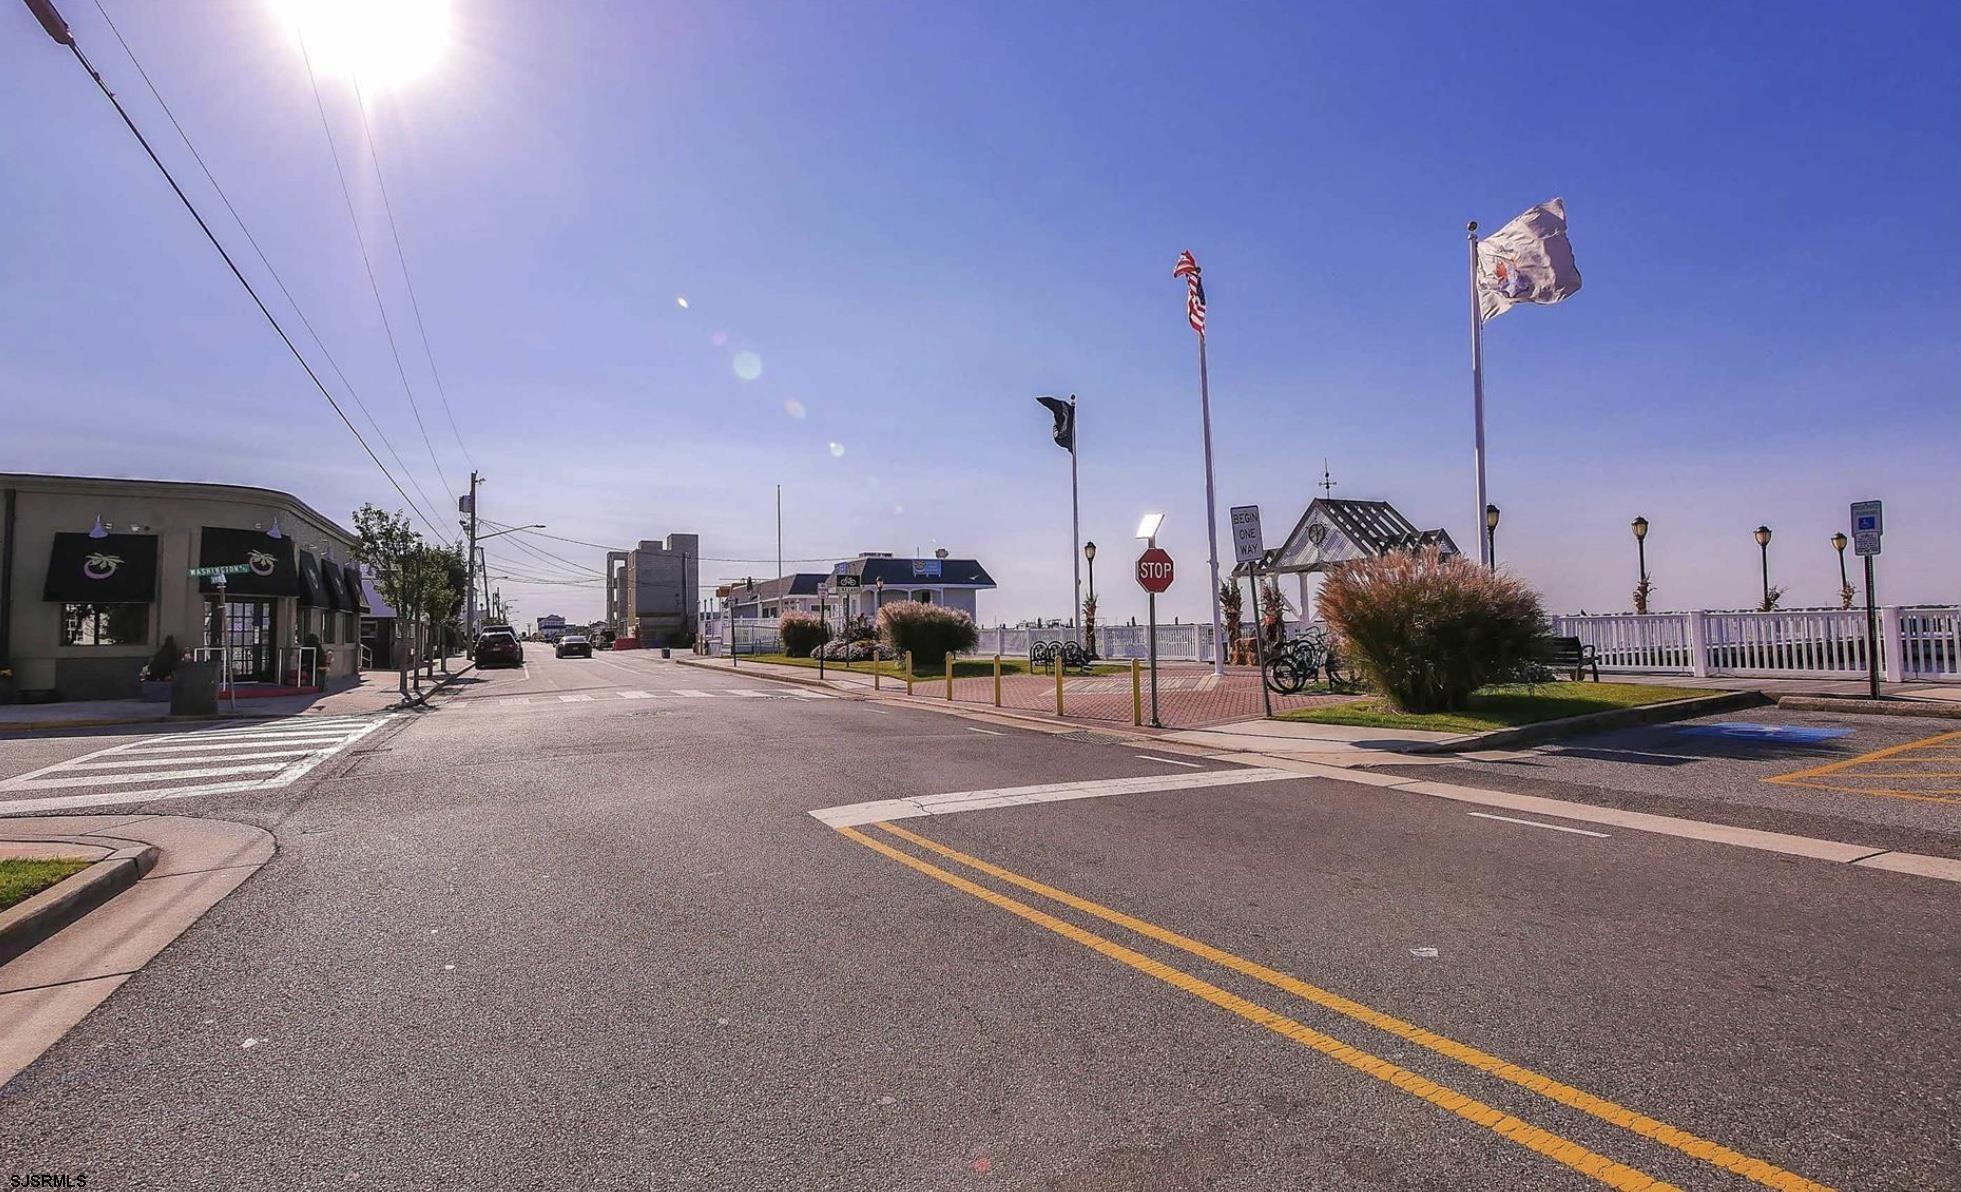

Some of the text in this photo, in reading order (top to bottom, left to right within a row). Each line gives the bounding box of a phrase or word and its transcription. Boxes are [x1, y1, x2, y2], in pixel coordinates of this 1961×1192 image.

[1233, 512, 1258, 525] BEGIN
[1240, 528, 1256, 540] ONE
[1241, 543, 1257, 556] WAY
[190, 565, 240, 576] WASHINGTON
[1140, 562, 1172, 579] STOP
